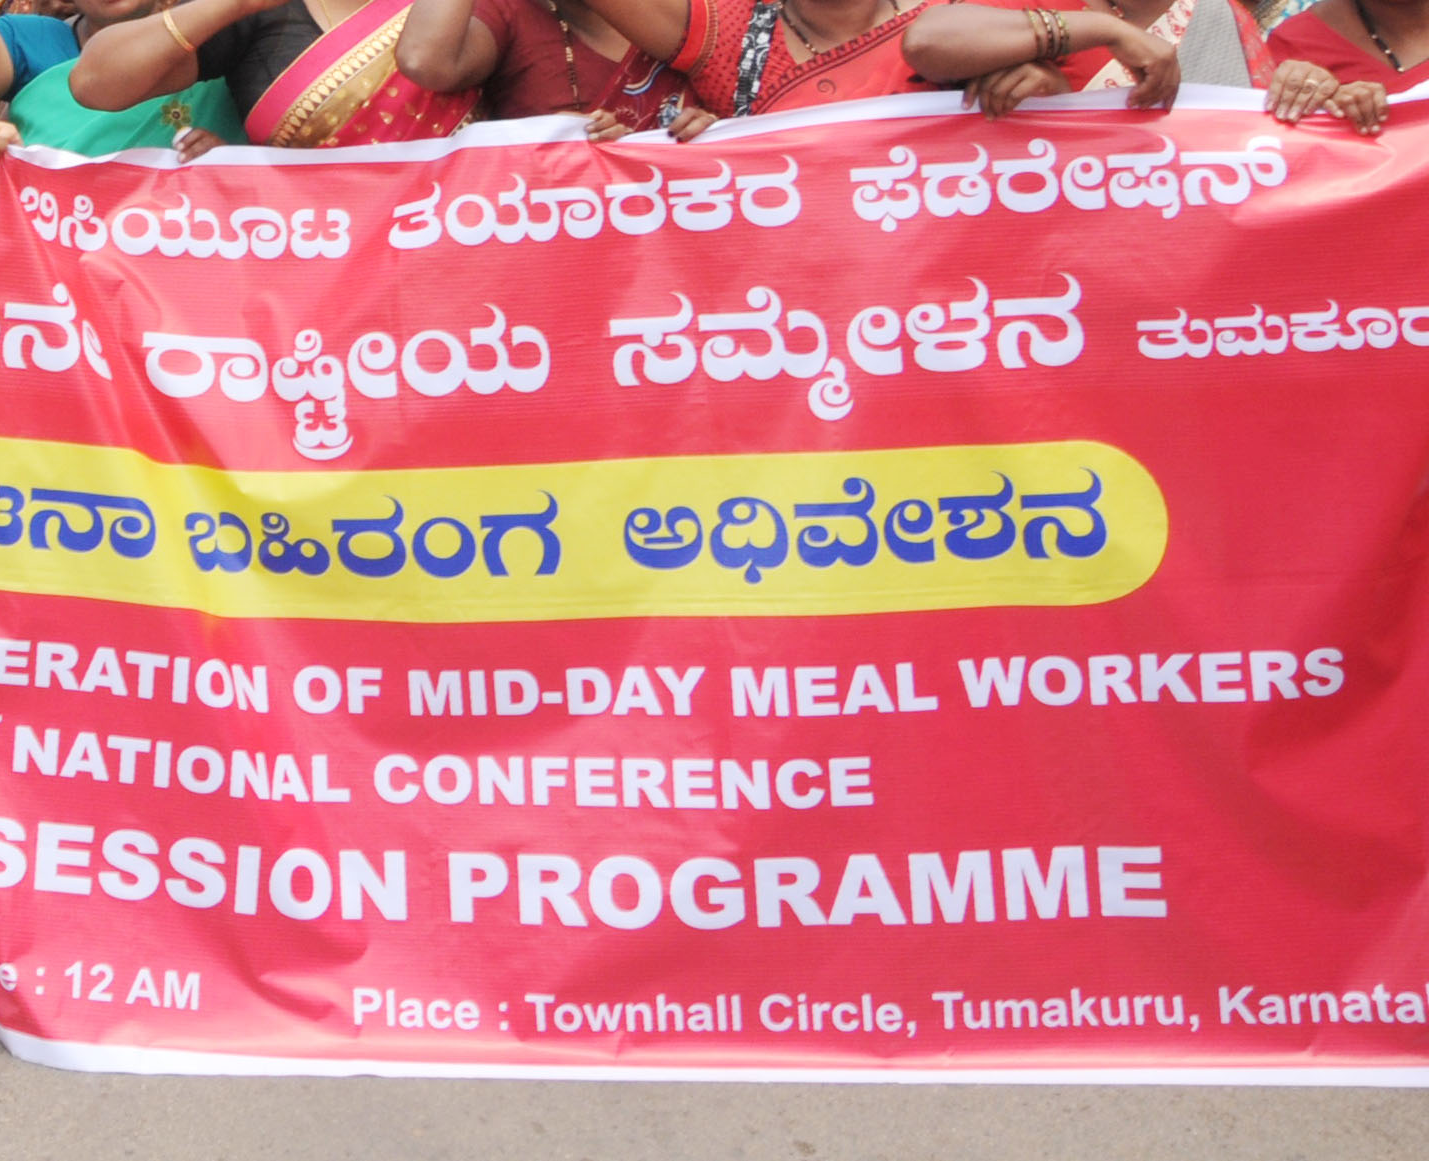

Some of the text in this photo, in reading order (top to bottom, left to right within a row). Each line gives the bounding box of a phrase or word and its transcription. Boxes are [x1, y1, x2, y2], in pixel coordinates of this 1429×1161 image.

[19, 183, 351, 261] ಬಿಸಿಯೂಟ
[387, 152, 802, 251] ತಯಾರಕರ
[848, 132, 1290, 236] ಫೆಡರೇಷನ್
[141, 302, 552, 462] ರಾಷ್ಟ್ರೀಯ
[610, 271, 1086, 422] ಸಮ್ಮೇಳನ
[182, 489, 562, 580] ಬಹಿರಂಗ
[622, 466, 1108, 584] ಅಧಿವೇಶನ
[292, 665, 384, 713] OF
[407, 665, 706, 719] MID-DAY
[729, 661, 938, 718] MEAL
[958, 647, 1345, 710] WORKERS
[10, 728, 350, 804] NATIONAL
[371, 754, 876, 810] CONFERENCE
[447, 844, 1168, 929] PROGRAMME
[65, 958, 127, 1006] 12
[133, 966, 201, 1012] AM
[352, 990, 482, 1030] Place
[525, 991, 742, 1034] Townhall
[757, 991, 918, 1039] Circle,
[932, 988, 1199, 1034] Tumakuru,
[1218, 981, 1429, 1025] Karnata
